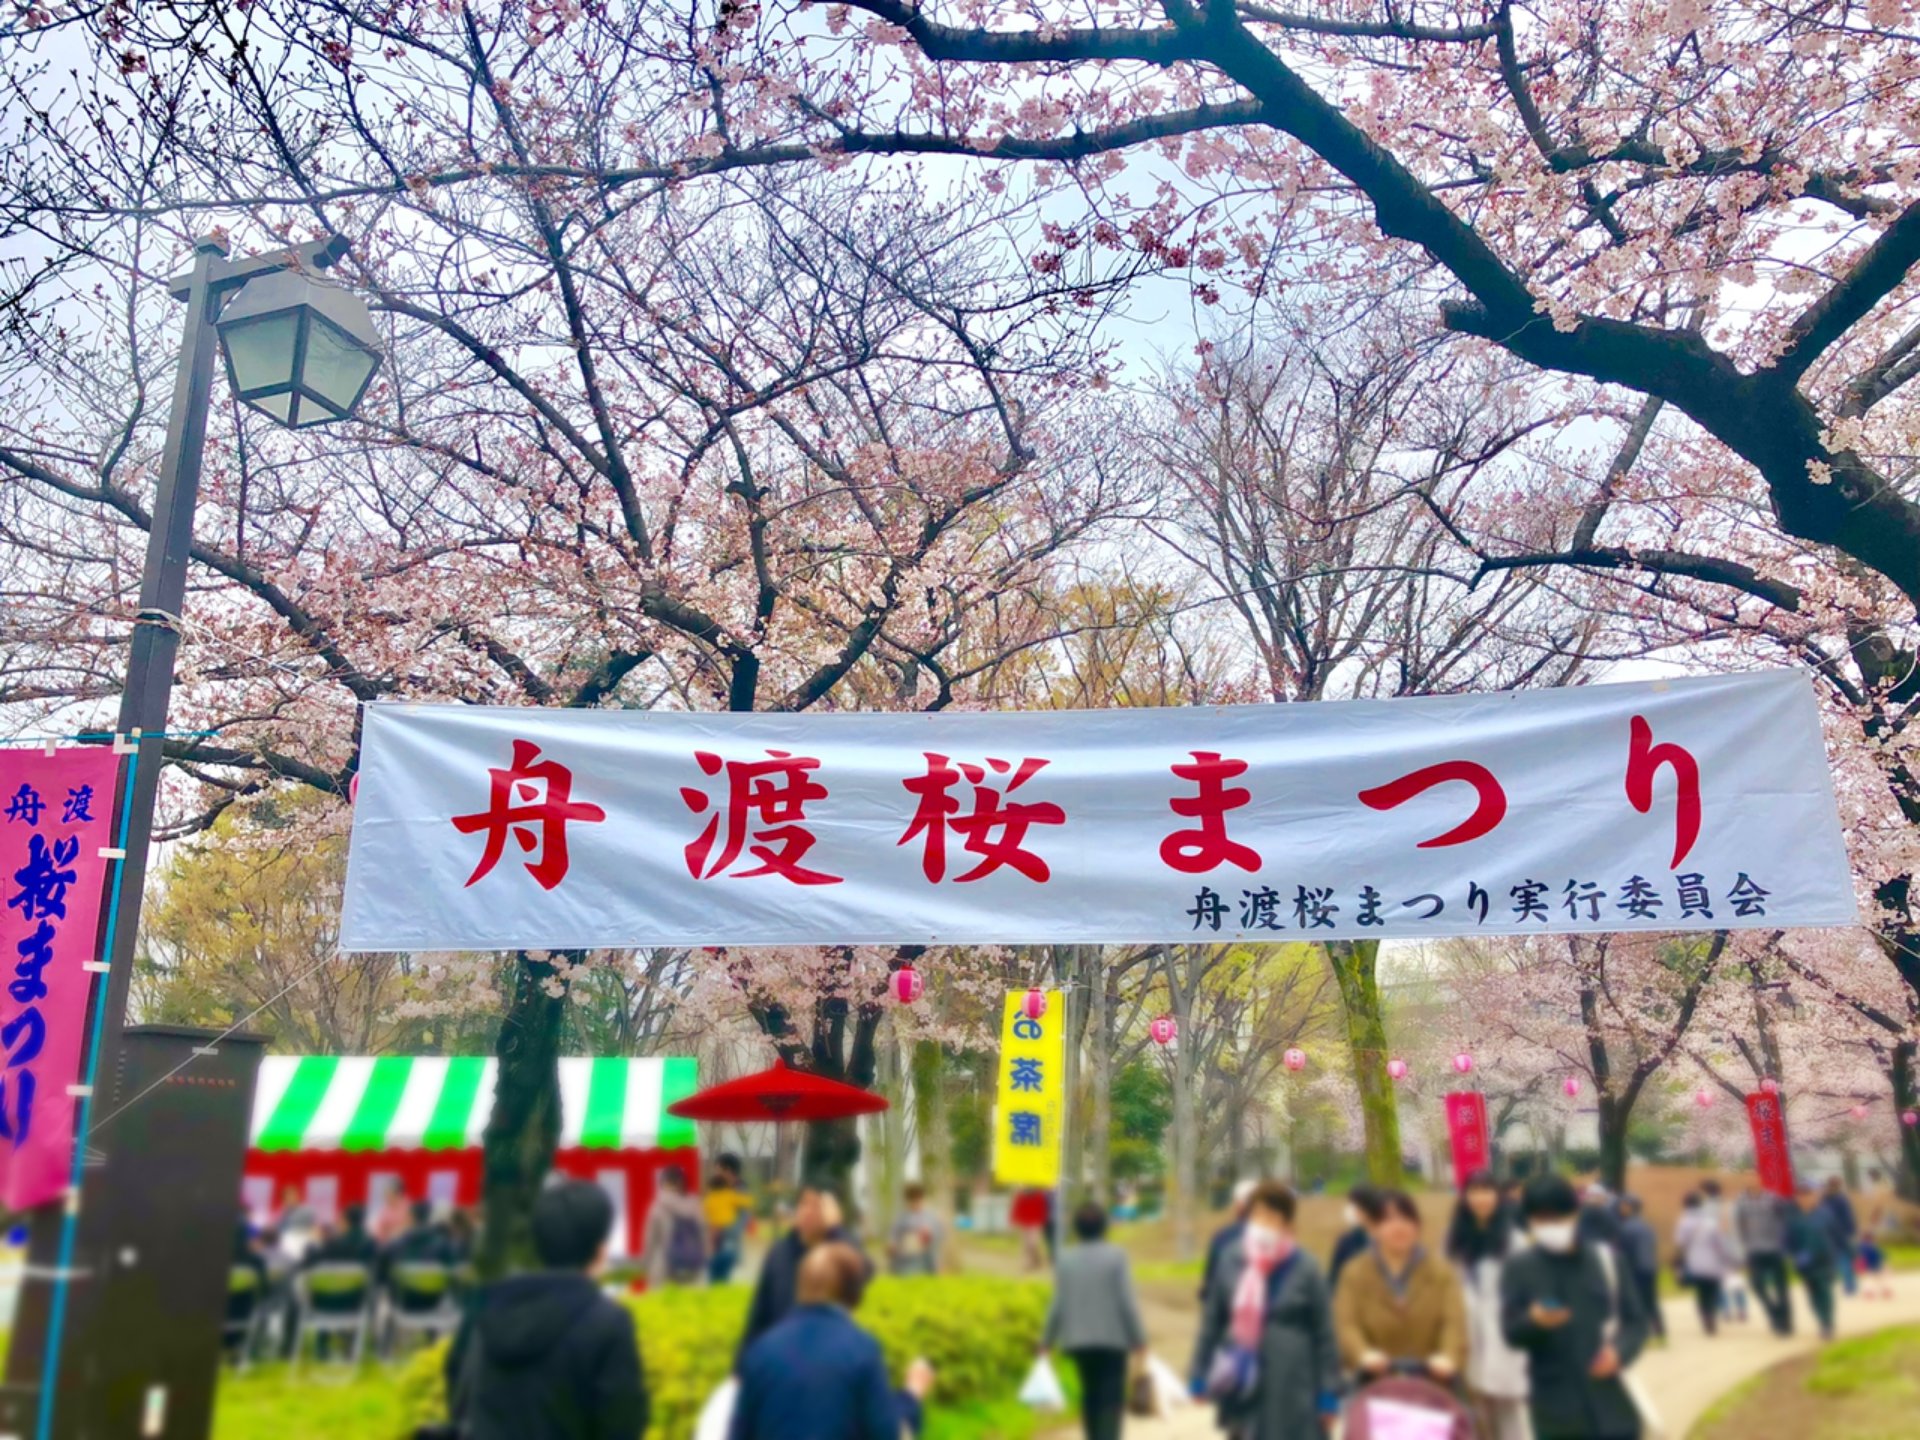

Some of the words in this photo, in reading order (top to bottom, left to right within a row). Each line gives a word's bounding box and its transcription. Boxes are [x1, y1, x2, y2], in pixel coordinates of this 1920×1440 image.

[3, 783, 96, 827] 舟渡
[452, 716, 1702, 891] 舟渡桜まつり
[1185, 872, 1771, 932] 舟渡桜まつり実行委員会
[0, 834, 80, 1151] 桜まつり
